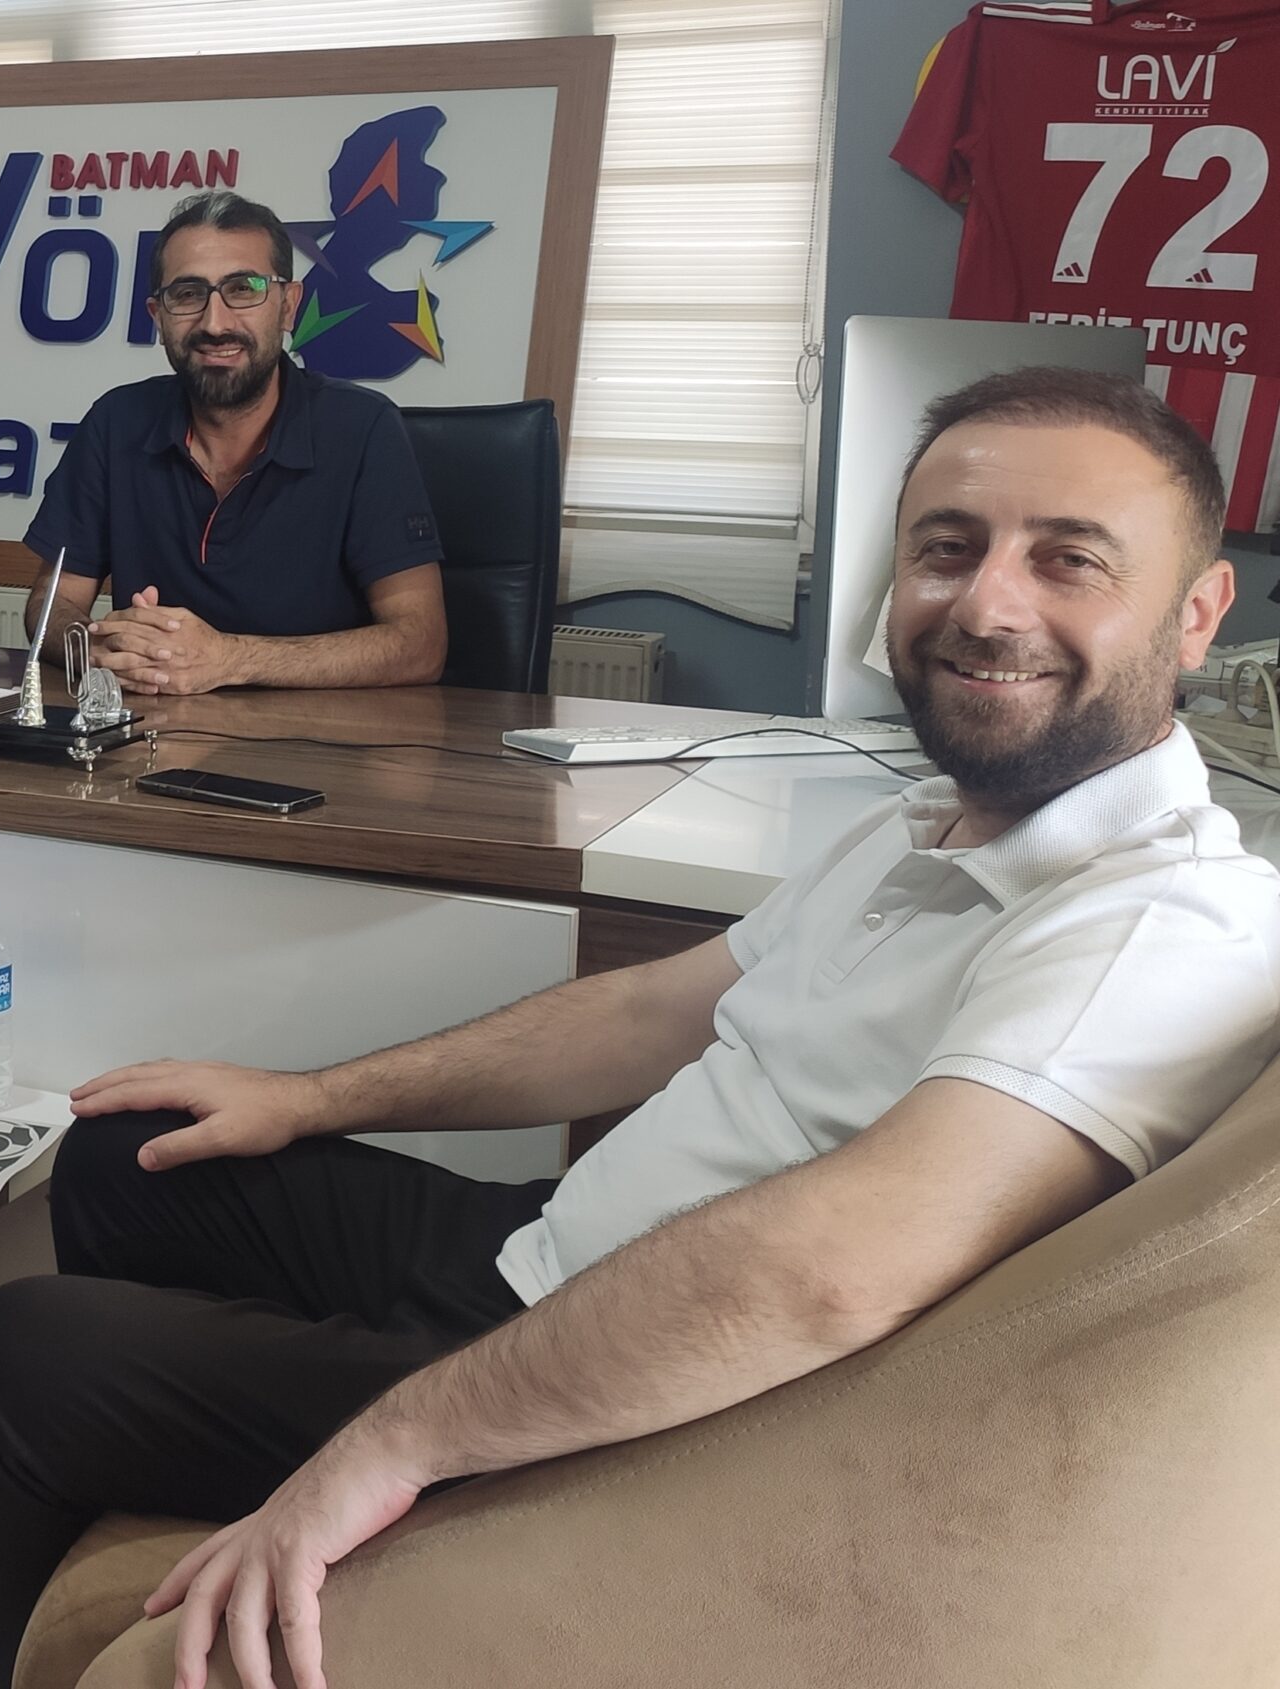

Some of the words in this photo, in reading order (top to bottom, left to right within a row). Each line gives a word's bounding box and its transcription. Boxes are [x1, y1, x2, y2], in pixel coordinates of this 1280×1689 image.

[1183, 107, 1209, 115] BAK
[50, 149, 239, 190] BATMAN
[1044, 123, 1269, 292] 72
[1142, 318, 1248, 365] TUNÇ
